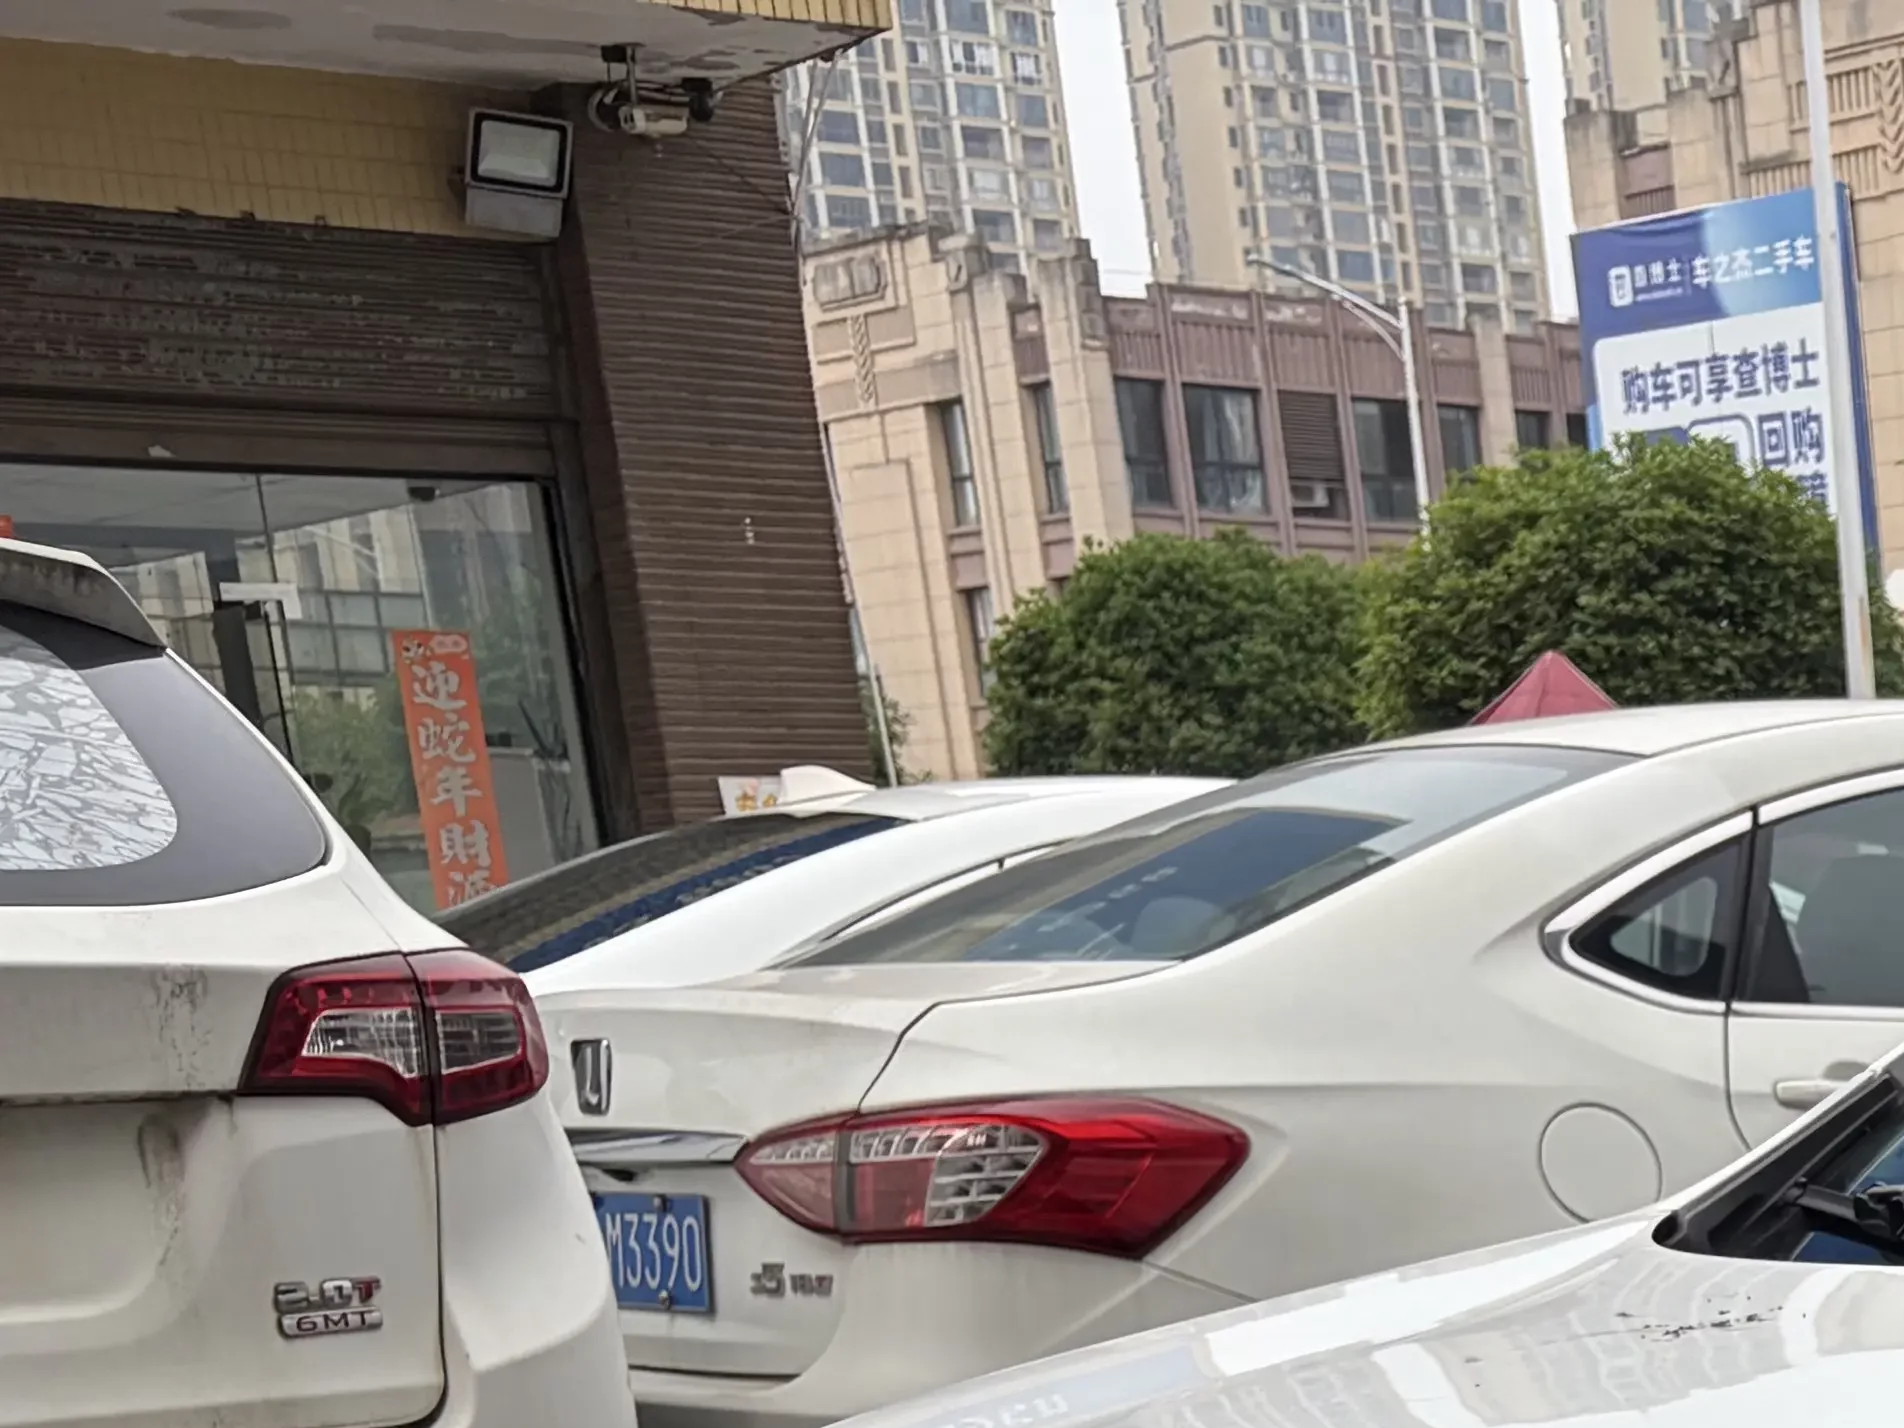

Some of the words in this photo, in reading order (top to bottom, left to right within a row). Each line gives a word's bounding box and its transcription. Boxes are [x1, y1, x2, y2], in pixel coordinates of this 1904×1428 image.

[1692, 235, 1815, 289] 车之杰二手车
[1622, 338, 1820, 414] 购车可享查博士
[1757, 407, 1825, 466] 回购
[605, 1213, 702, 1292] M3390
[296, 1311, 367, 1332] 6MT
